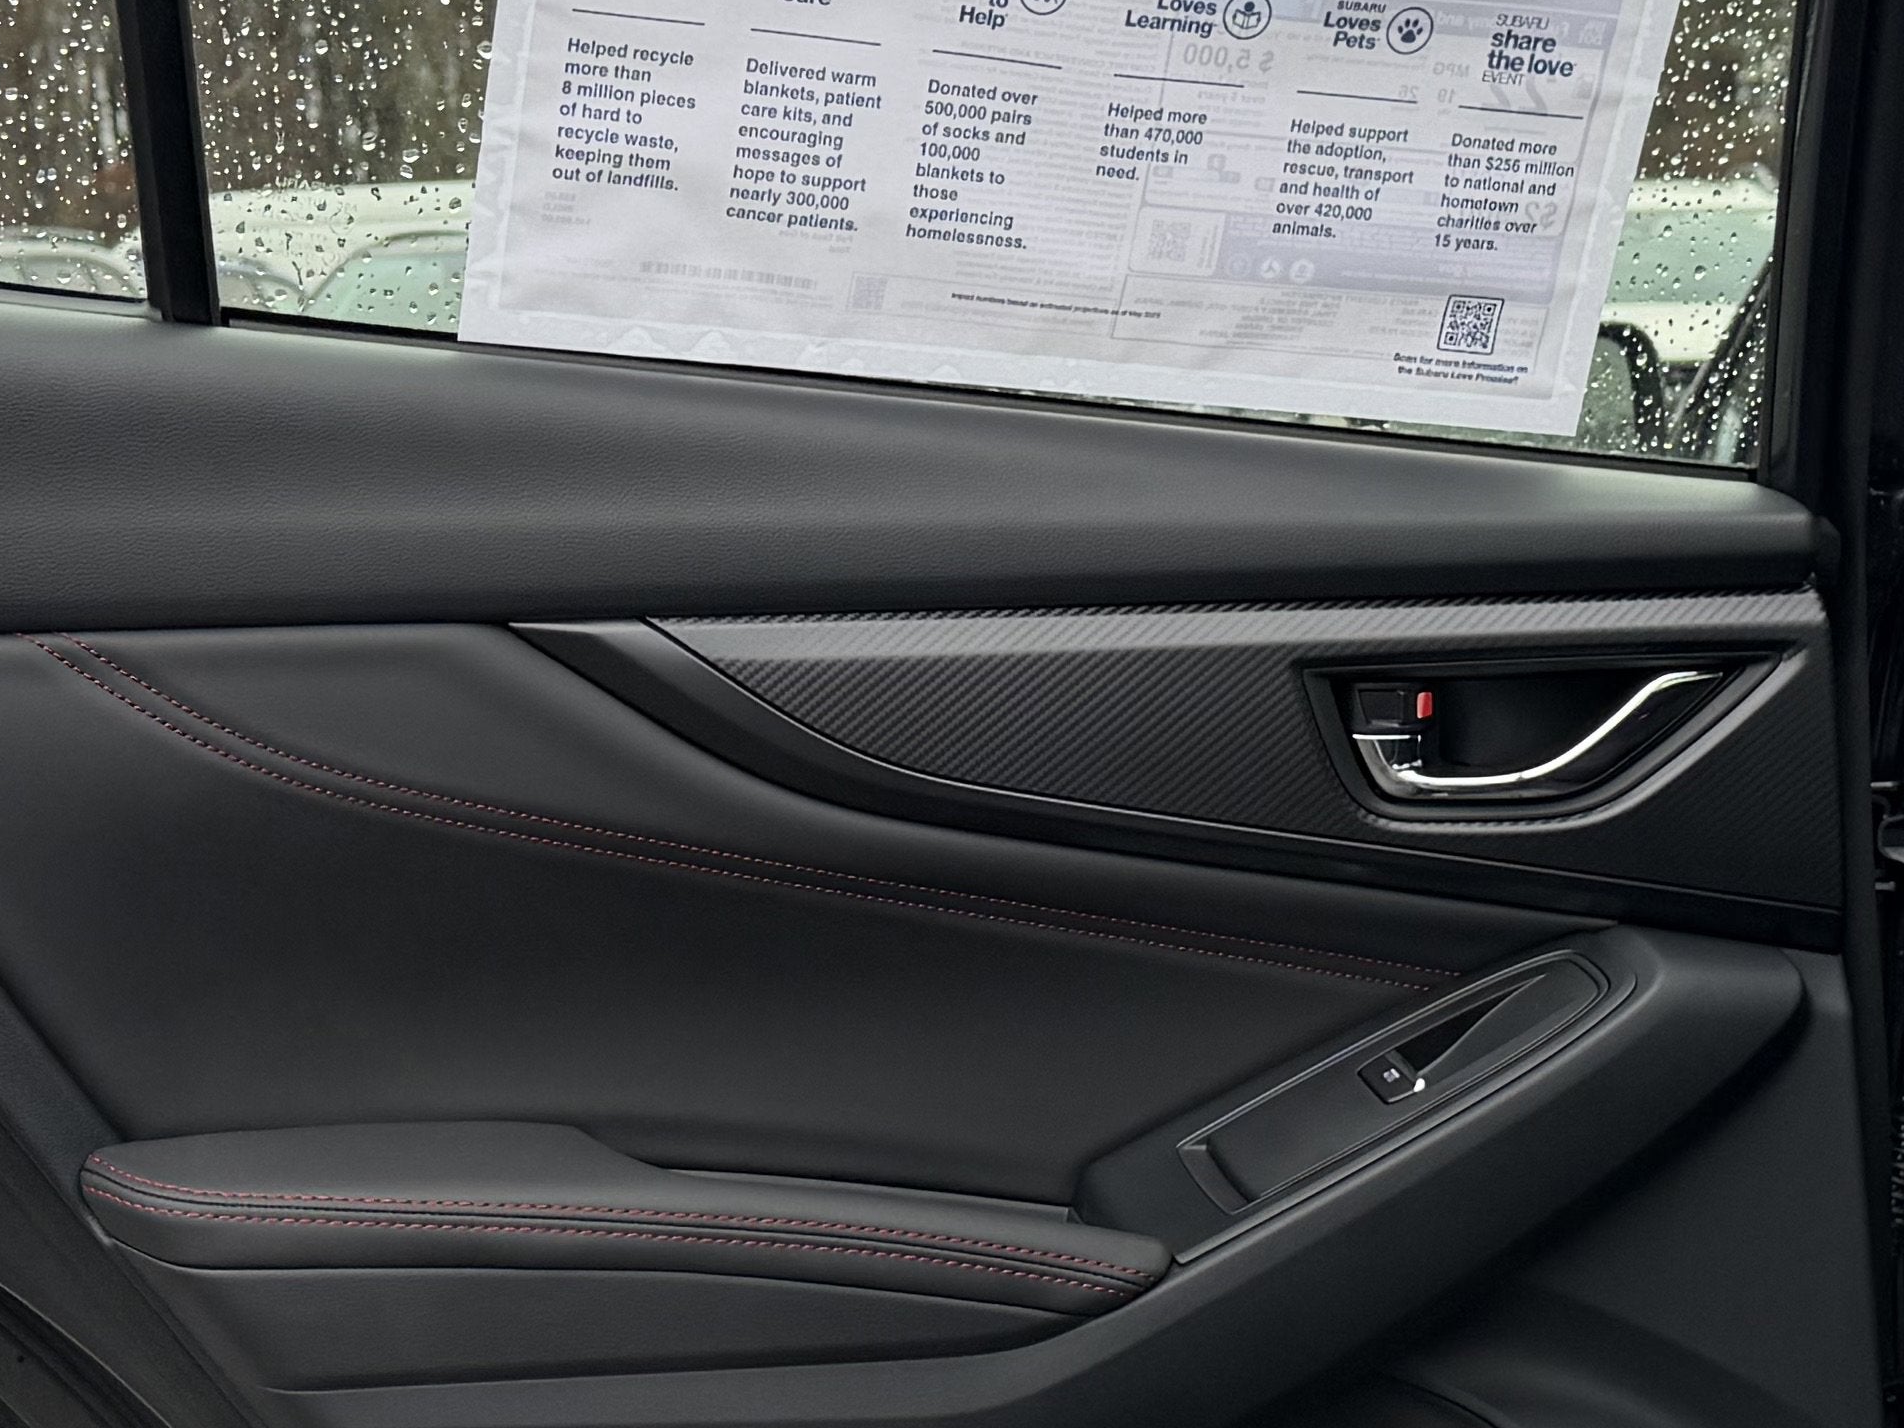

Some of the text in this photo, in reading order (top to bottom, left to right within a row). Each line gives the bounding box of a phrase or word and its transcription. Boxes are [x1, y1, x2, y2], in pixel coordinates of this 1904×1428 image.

[1336, 0, 1387, 14] SUBARU
[1323, 10, 1382, 33] Loves
[1495, 14, 1550, 30] SUBARU
[567, 37, 694, 67] Helped recycle
[1490, 28, 1557, 54] share
[564, 62, 652, 83] more than
[746, 57, 877, 88] Delivered warm
[1487, 49, 1525, 73] the
[1481, 70, 1524, 85] EVENT
[561, 80, 696, 110] 8 million pieces
[743, 78, 882, 110] blankets, patient
[927, 78, 1039, 106] Donated over
[559, 101, 643, 125] of hard to
[740, 103, 854, 128] care kits, and
[924, 99, 1032, 126] 500,000 pairs
[1107, 102, 1208, 125] Helped more
[557, 126, 679, 154] recycle waste,
[738, 125, 844, 151] encouraging
[921, 121, 1027, 146] of socks and
[1103, 123, 1204, 146] than 470,000
[1290, 118, 1409, 144] Helped support
[920, 141, 981, 162] 100,000
[1099, 144, 1189, 165] students in
[1286, 138, 1387, 164] the adoption,
[1451, 132, 1558, 156] Donated more
[554, 143, 671, 172] keeping them
[735, 146, 843, 169] messages of
[1447, 153, 1575, 177] than $256 million
[552, 167, 679, 191] out of landfills.
[732, 164, 867, 193] hope to support
[915, 162, 1006, 185] blankets to
[1095, 165, 1140, 181] need.
[1283, 162, 1414, 185] rescue, transport
[1444, 173, 1557, 197] to national and
[729, 187, 850, 211] nearly 300,000
[913, 183, 958, 202] those
[1279, 181, 1381, 202] and health of
[1440, 193, 1519, 213] hometown
[725, 206, 858, 232] cancer patients.
[909, 206, 1014, 231] experiencing
[1275, 202, 1373, 221] over 420,000
[1436, 213, 1501, 231] charities
[1504, 221, 1538, 234] over
[905, 223, 1027, 250] homelessness.
[1272, 220, 1337, 239] animals.
[1434, 233, 1498, 252] 15 years.
